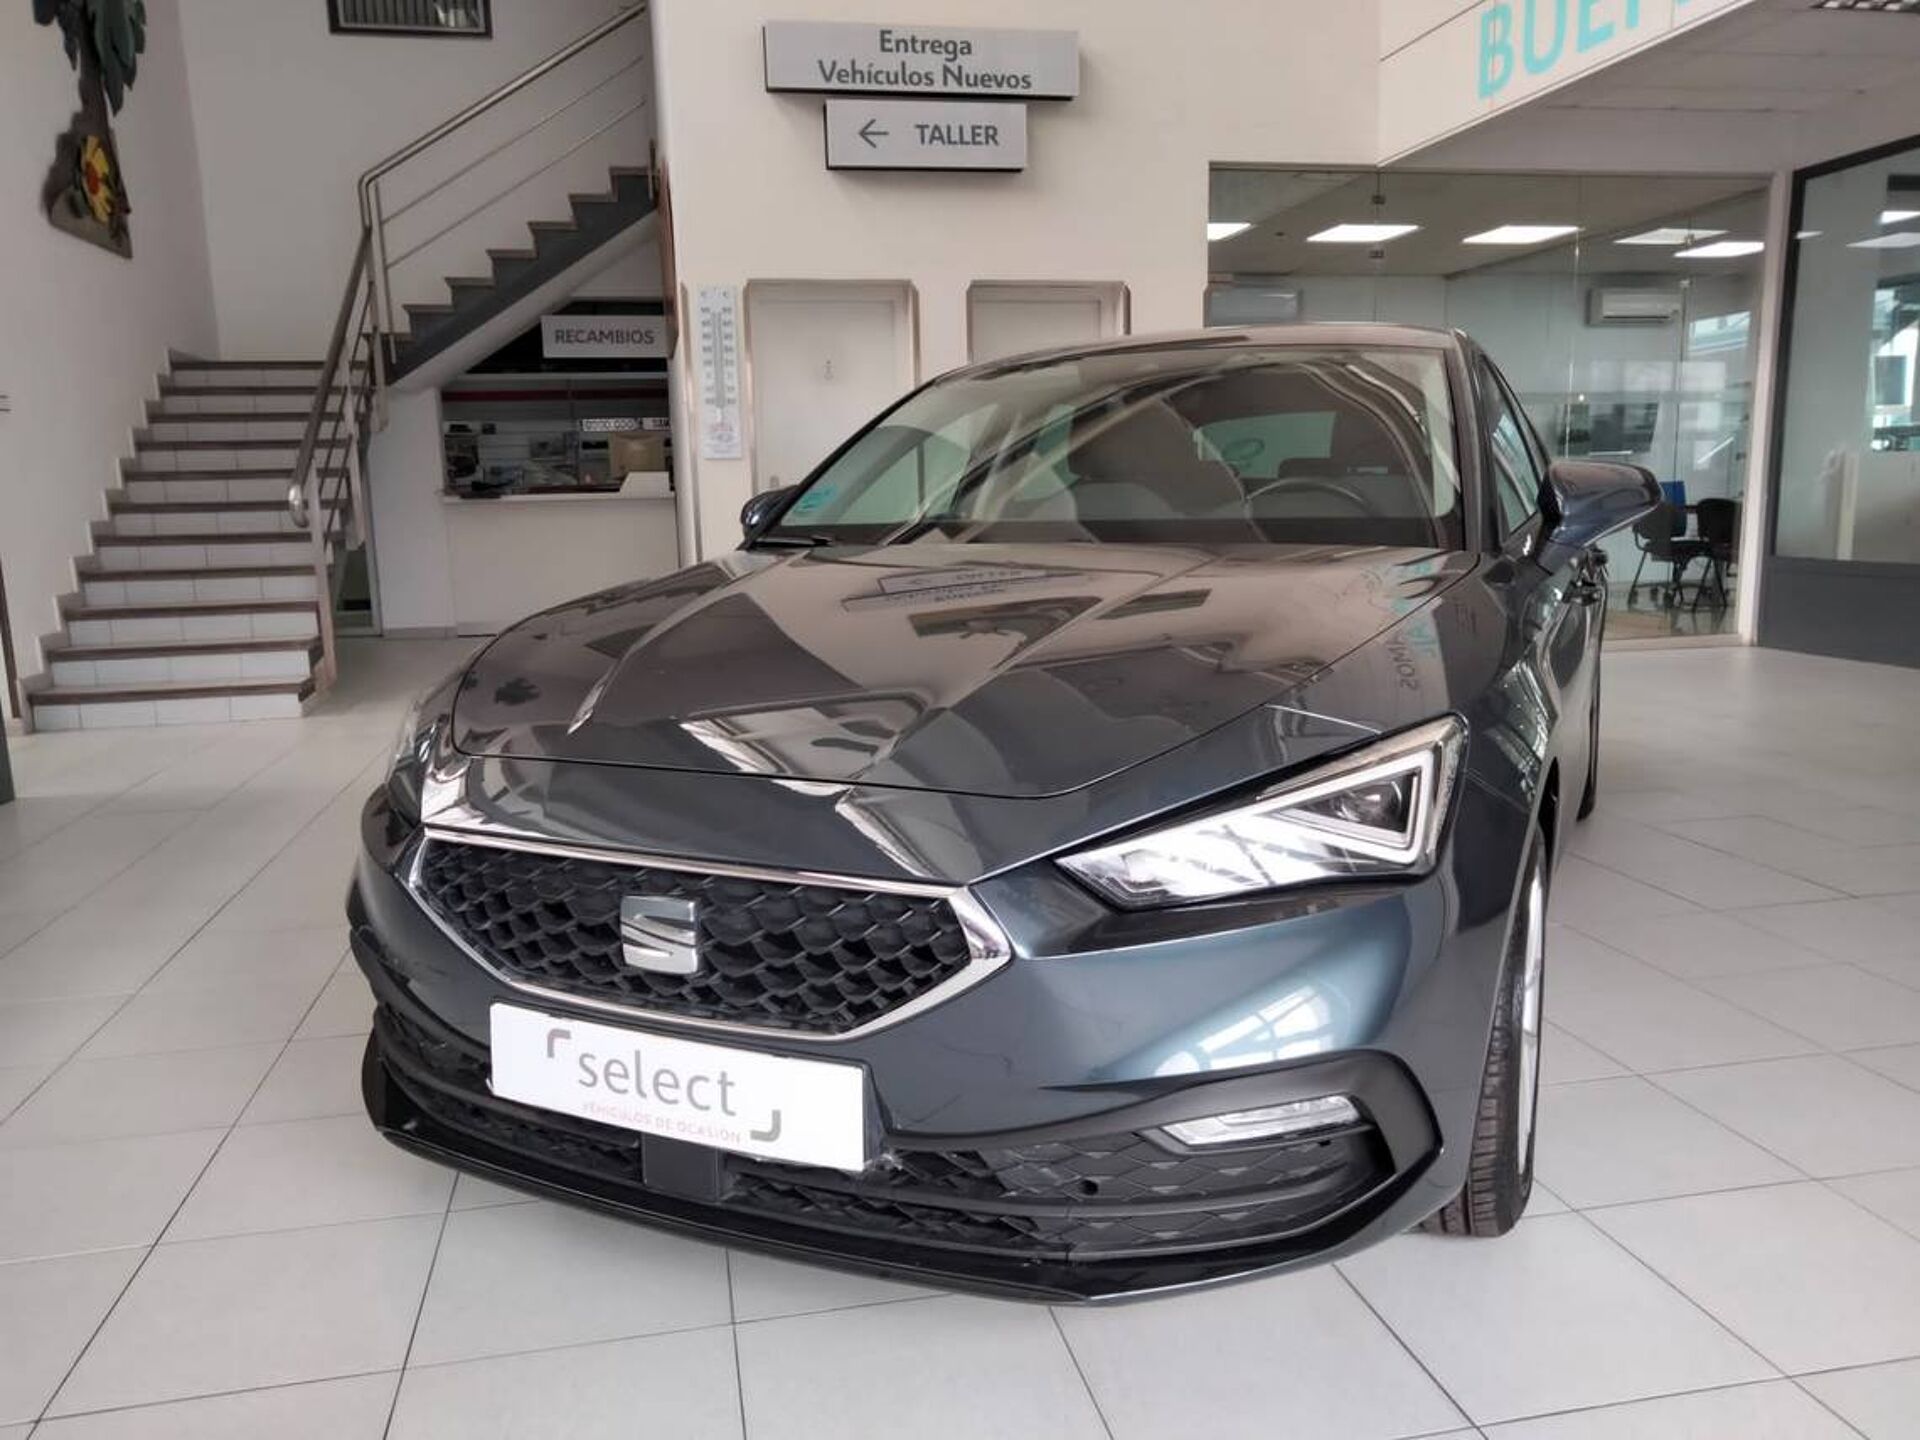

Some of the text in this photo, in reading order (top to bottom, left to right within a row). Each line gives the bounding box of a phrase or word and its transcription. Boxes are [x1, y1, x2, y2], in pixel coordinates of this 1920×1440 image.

[879, 30, 973, 62] Entrega
[818, 60, 1033, 90] Vehículos Nuevos
[915, 124, 1000, 147] TALLER
[555, 328, 655, 346] RECAMBIOS
[577, 1050, 737, 1117] select
